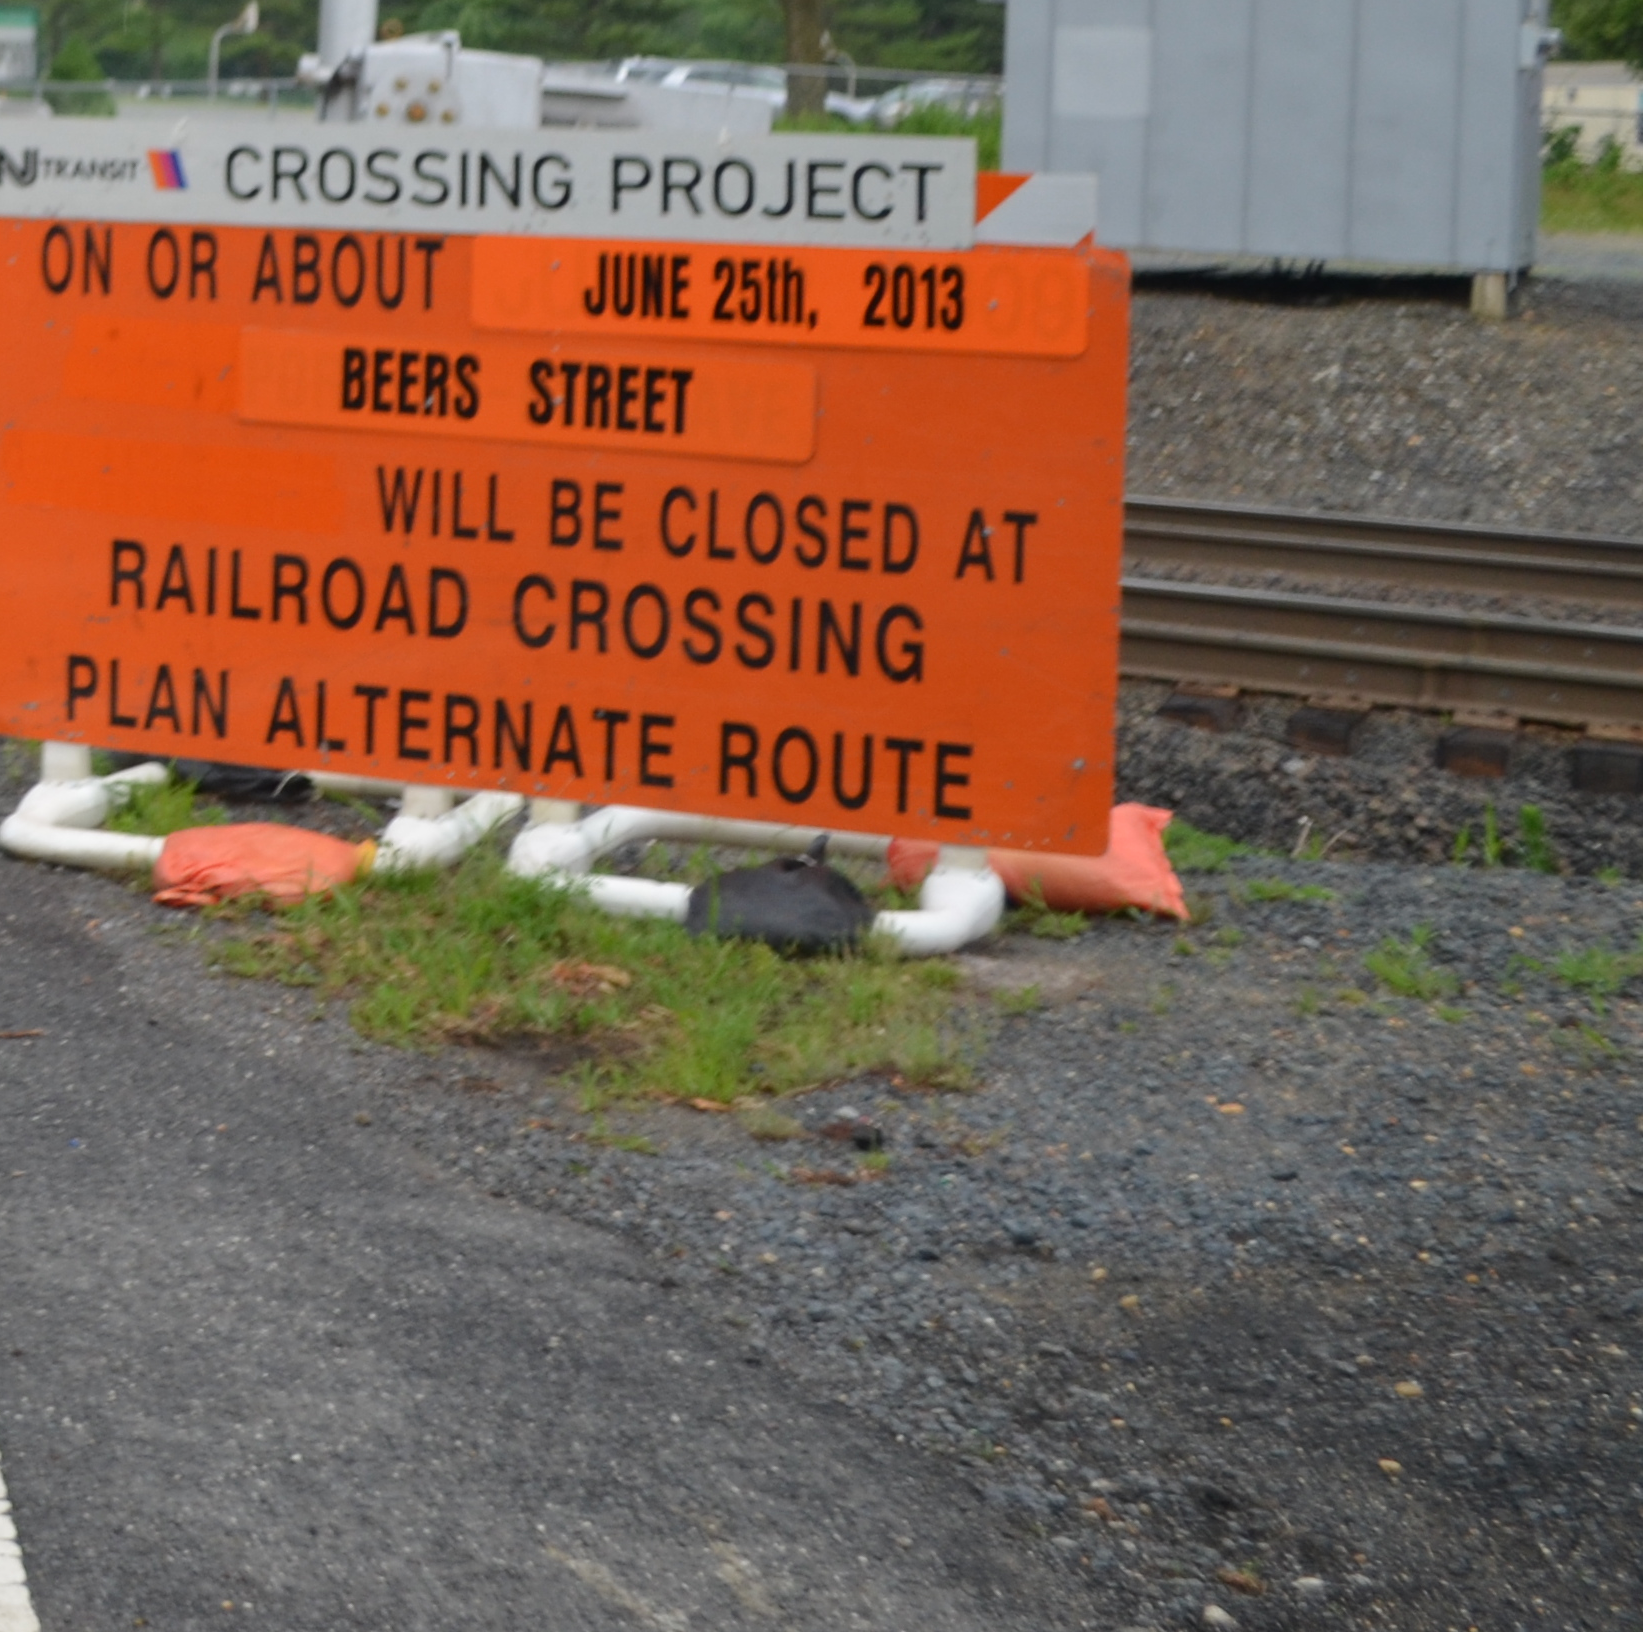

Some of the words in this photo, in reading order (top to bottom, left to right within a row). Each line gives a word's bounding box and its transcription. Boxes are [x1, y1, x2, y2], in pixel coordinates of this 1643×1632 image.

[44, 159, 137, 180] TRANSIT
[226, 146, 572, 210] CROSSING
[612, 157, 942, 222] PROJECT
[42, 223, 111, 294] ON
[147, 227, 217, 299] OR
[252, 233, 444, 310] ABOUT
[584, 254, 689, 319] JUNE
[713, 259, 817, 328] 25th,
[864, 264, 964, 331] 2013
[342, 348, 479, 419] BEERS
[529, 360, 692, 434] STREET
[377, 467, 514, 542] WILL
[550, 479, 623, 551] BE
[660, 486, 919, 574] CLOSED
[956, 509, 1037, 583] AT
[111, 539, 470, 638] RAILROAD
[513, 573, 923, 683] CROSSING
[66, 655, 228, 738] PLAN
[267, 678, 675, 788] ALTERNATE
[720, 722, 972, 820] ROUTE
